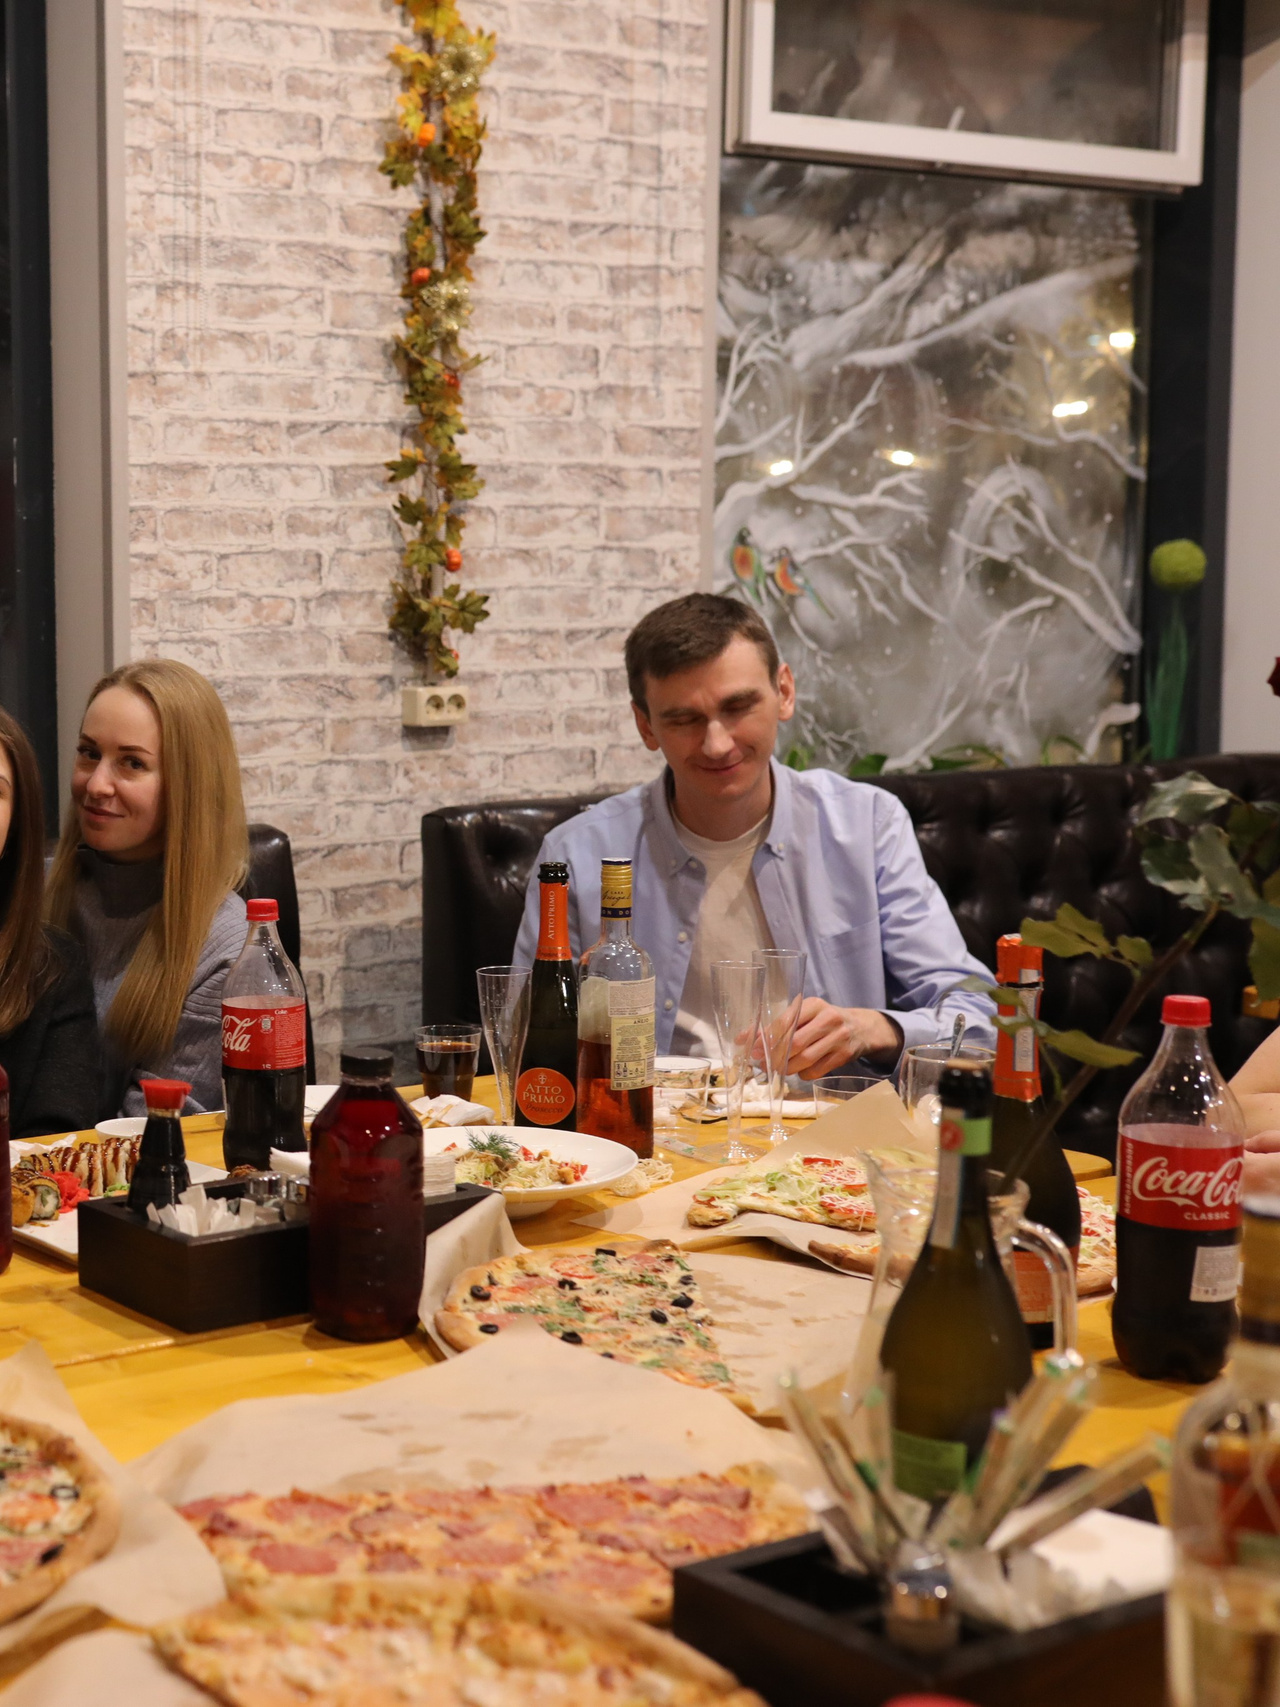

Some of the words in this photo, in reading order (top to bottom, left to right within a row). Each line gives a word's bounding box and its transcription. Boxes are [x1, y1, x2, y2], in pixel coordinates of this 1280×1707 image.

[548, 890, 556, 917] PRIMO
[547, 918, 556, 940] ATTO
[522, 1091, 566, 1104] PRIMO
[525, 1083, 562, 1095] ATTO
[1132, 1156, 1244, 1208] Coca-Col
[1183, 1211, 1230, 1221] CLASSIC
